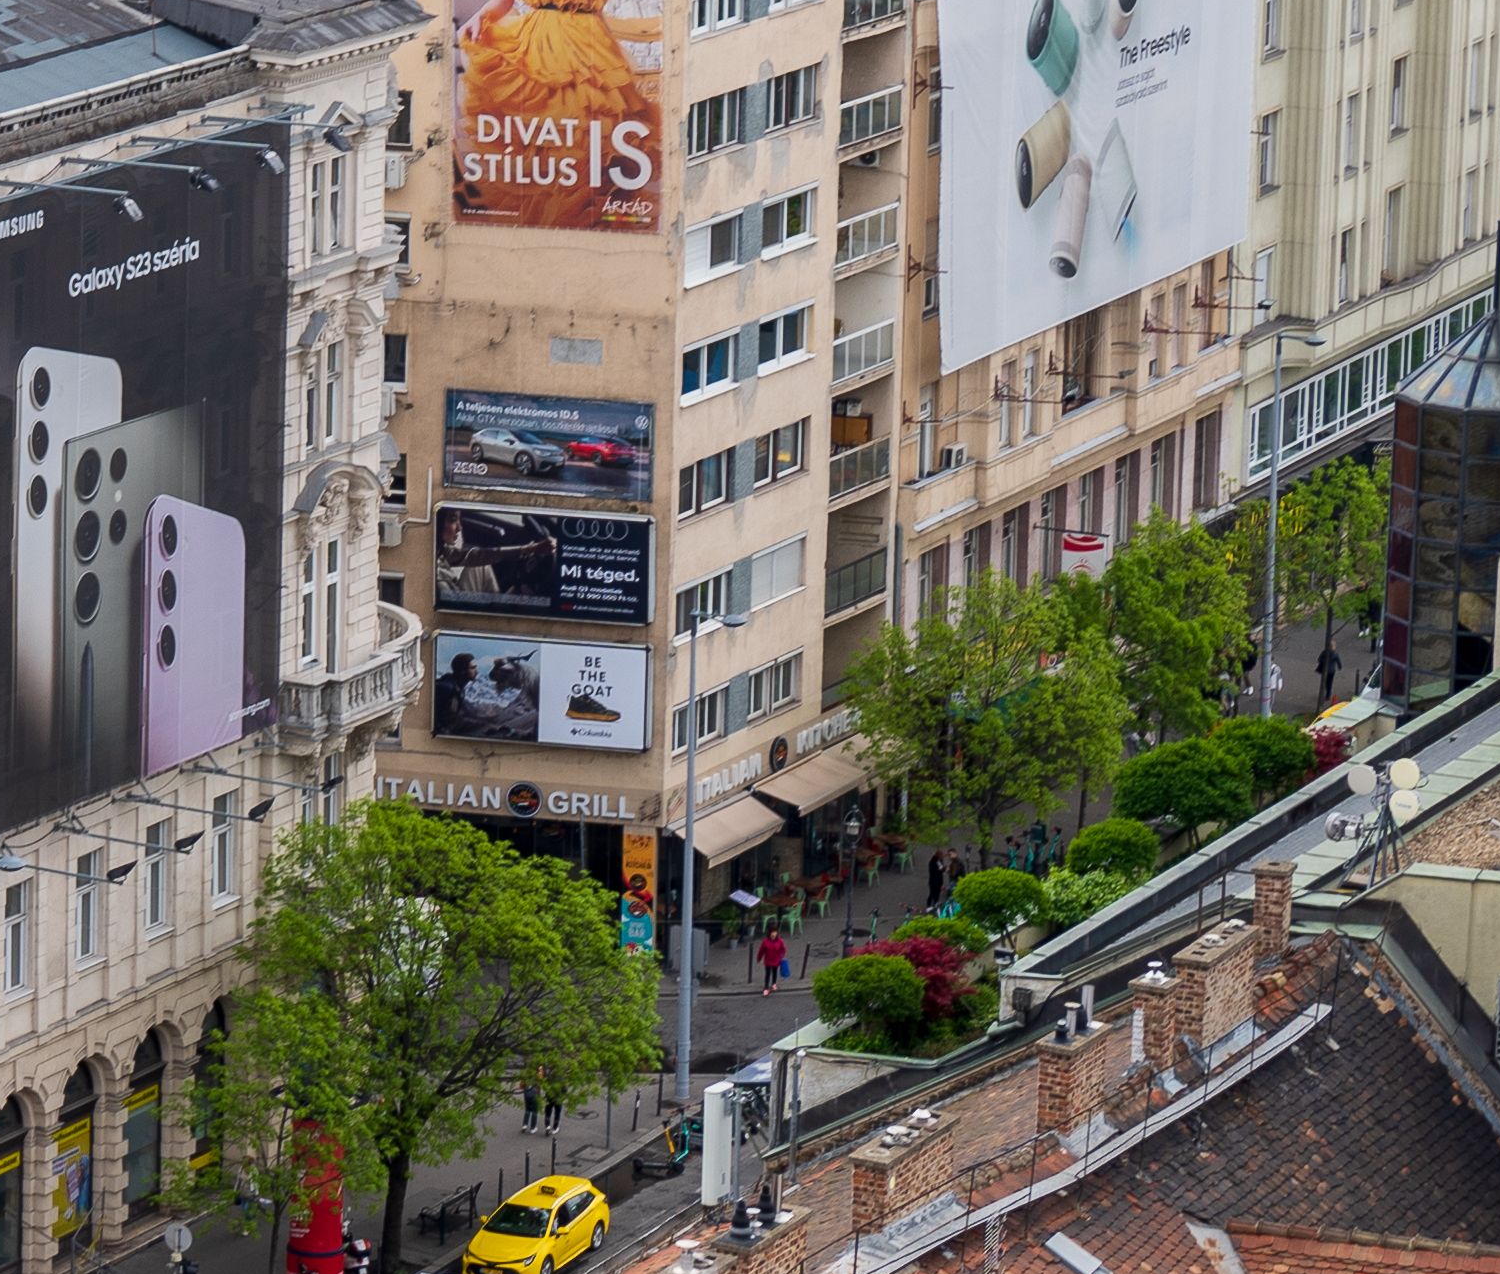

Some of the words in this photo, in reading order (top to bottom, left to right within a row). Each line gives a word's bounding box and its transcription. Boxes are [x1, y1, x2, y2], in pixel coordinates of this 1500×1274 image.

[1119, 41, 1138, 69] The
[1140, 25, 1191, 64] Freestyle
[477, 114, 579, 147] DIVAT
[463, 146, 578, 187] STÍLUS
[589, 120, 652, 191] IS
[68, 262, 126, 298] Galaxy
[126, 251, 151, 280] S23
[153, 236, 200, 272] széria
[456, 401, 464, 410] A
[561, 565, 582, 578] Mi
[585, 567, 640, 583] téged.
[579, 670, 606, 683] THE
[585, 656, 602, 668] BE
[572, 684, 613, 697] GOAT
[694, 753, 762, 804] ITALIAN
[796, 707, 862, 754] KITCHE
[376, 776, 500, 809] ITALIAN
[547, 790, 635, 820] GRILL
